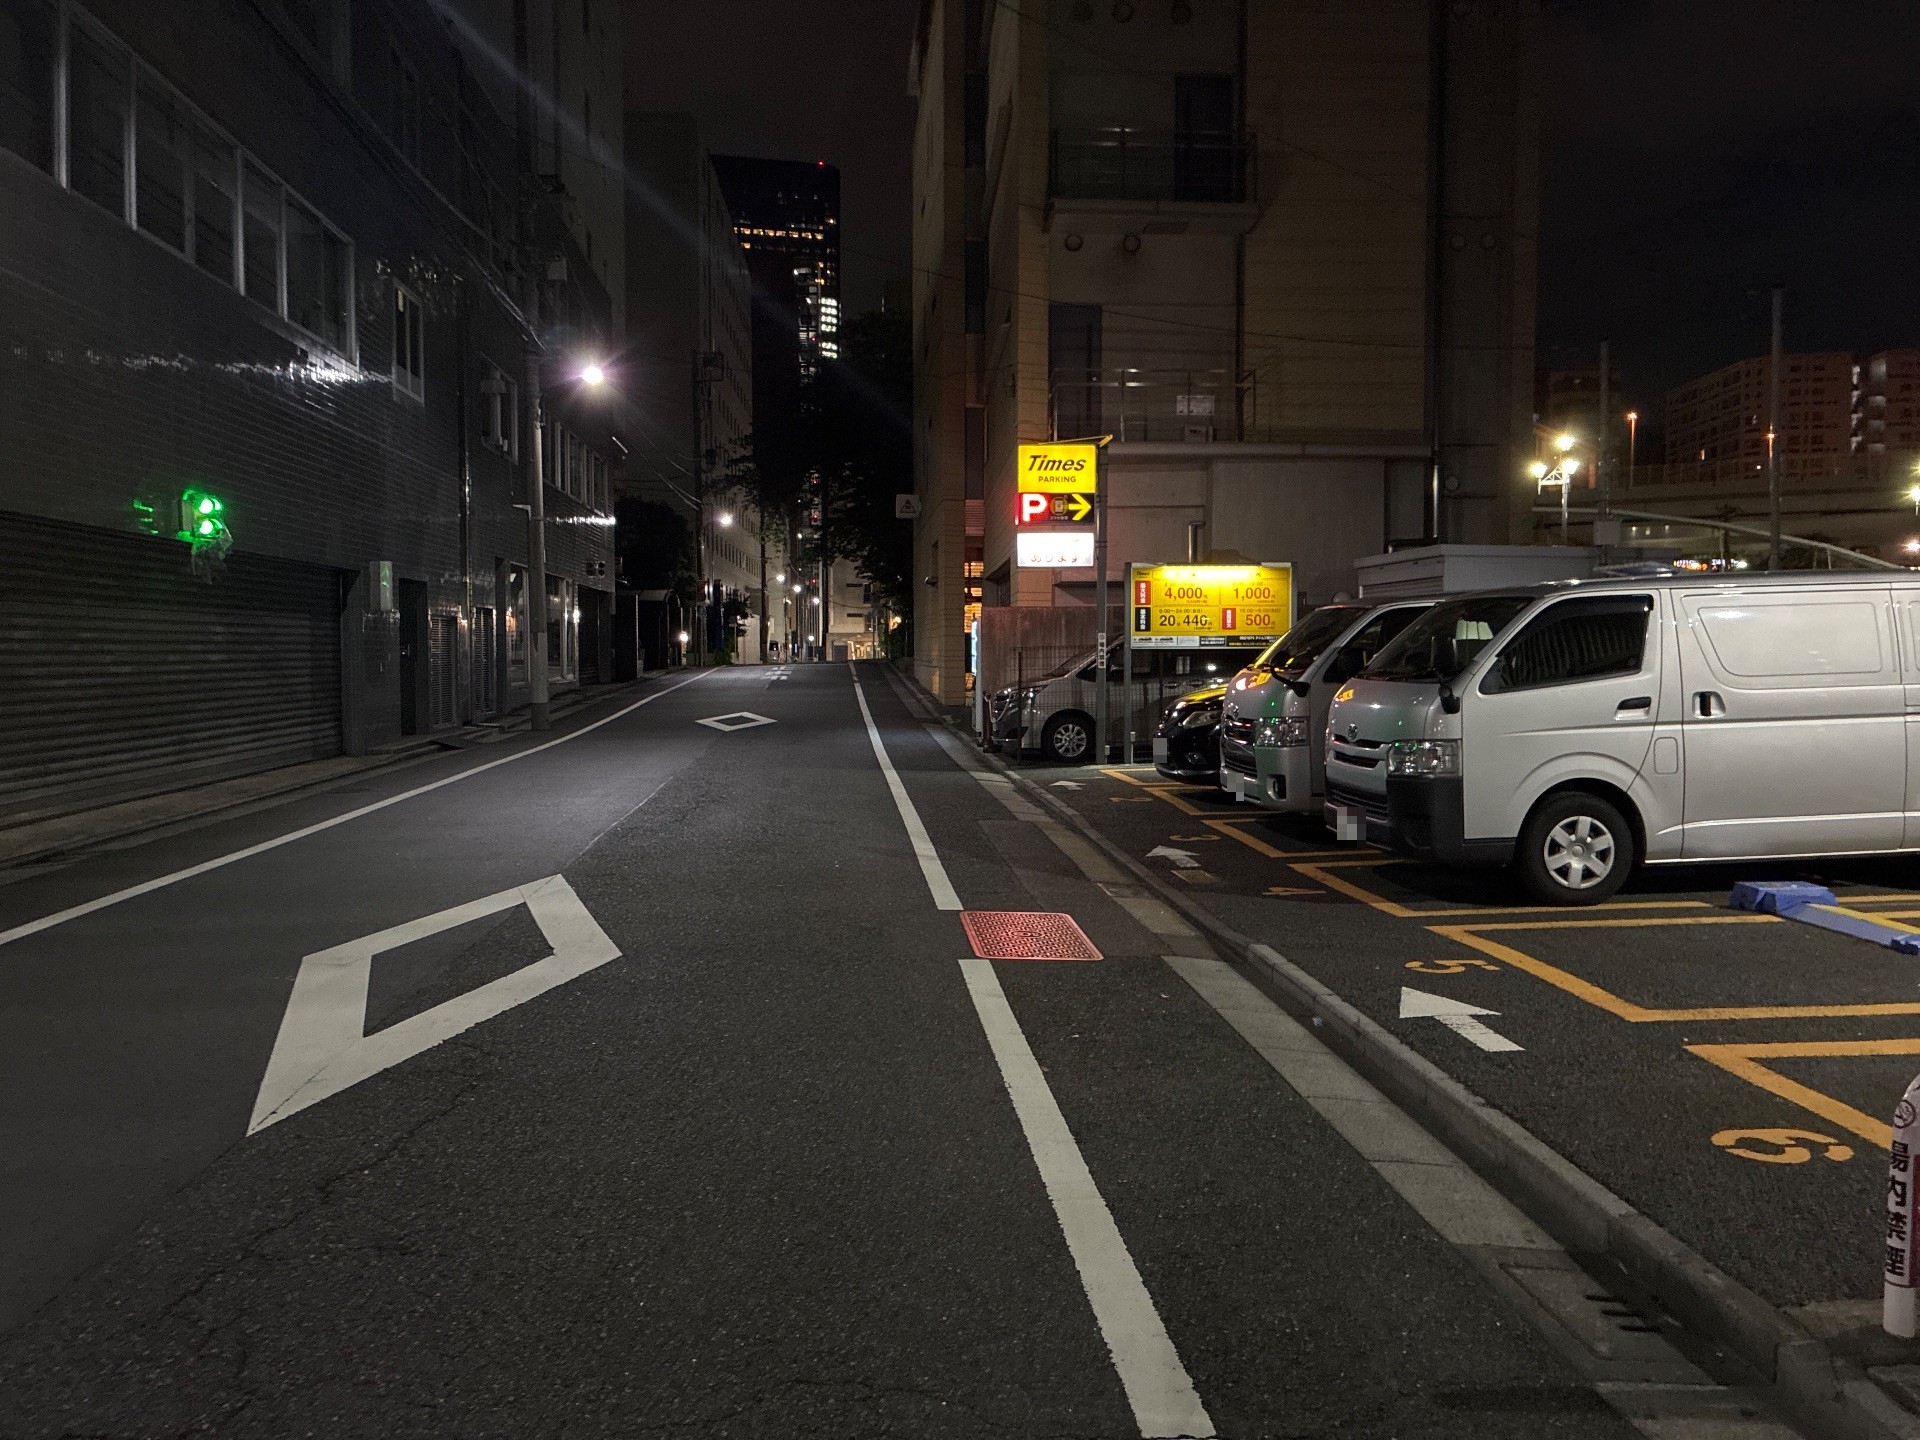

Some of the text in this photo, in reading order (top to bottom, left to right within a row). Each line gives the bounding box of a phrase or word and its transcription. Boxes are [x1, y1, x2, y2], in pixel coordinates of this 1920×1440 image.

[1028, 455, 1087, 471] Times
[1022, 493, 1048, 522] P
[1164, 587, 1203, 601] 4,000
[1233, 587, 1271, 601] 1,000
[1159, 614, 1176, 627] 20
[1183, 614, 1208, 627] 440
[1245, 613, 1271, 626] 500
[1169, 834, 1222, 842] 3
[1261, 885, 1328, 896] 4
[1404, 958, 1501, 974] 5
[1710, 1127, 1855, 1165] 6
